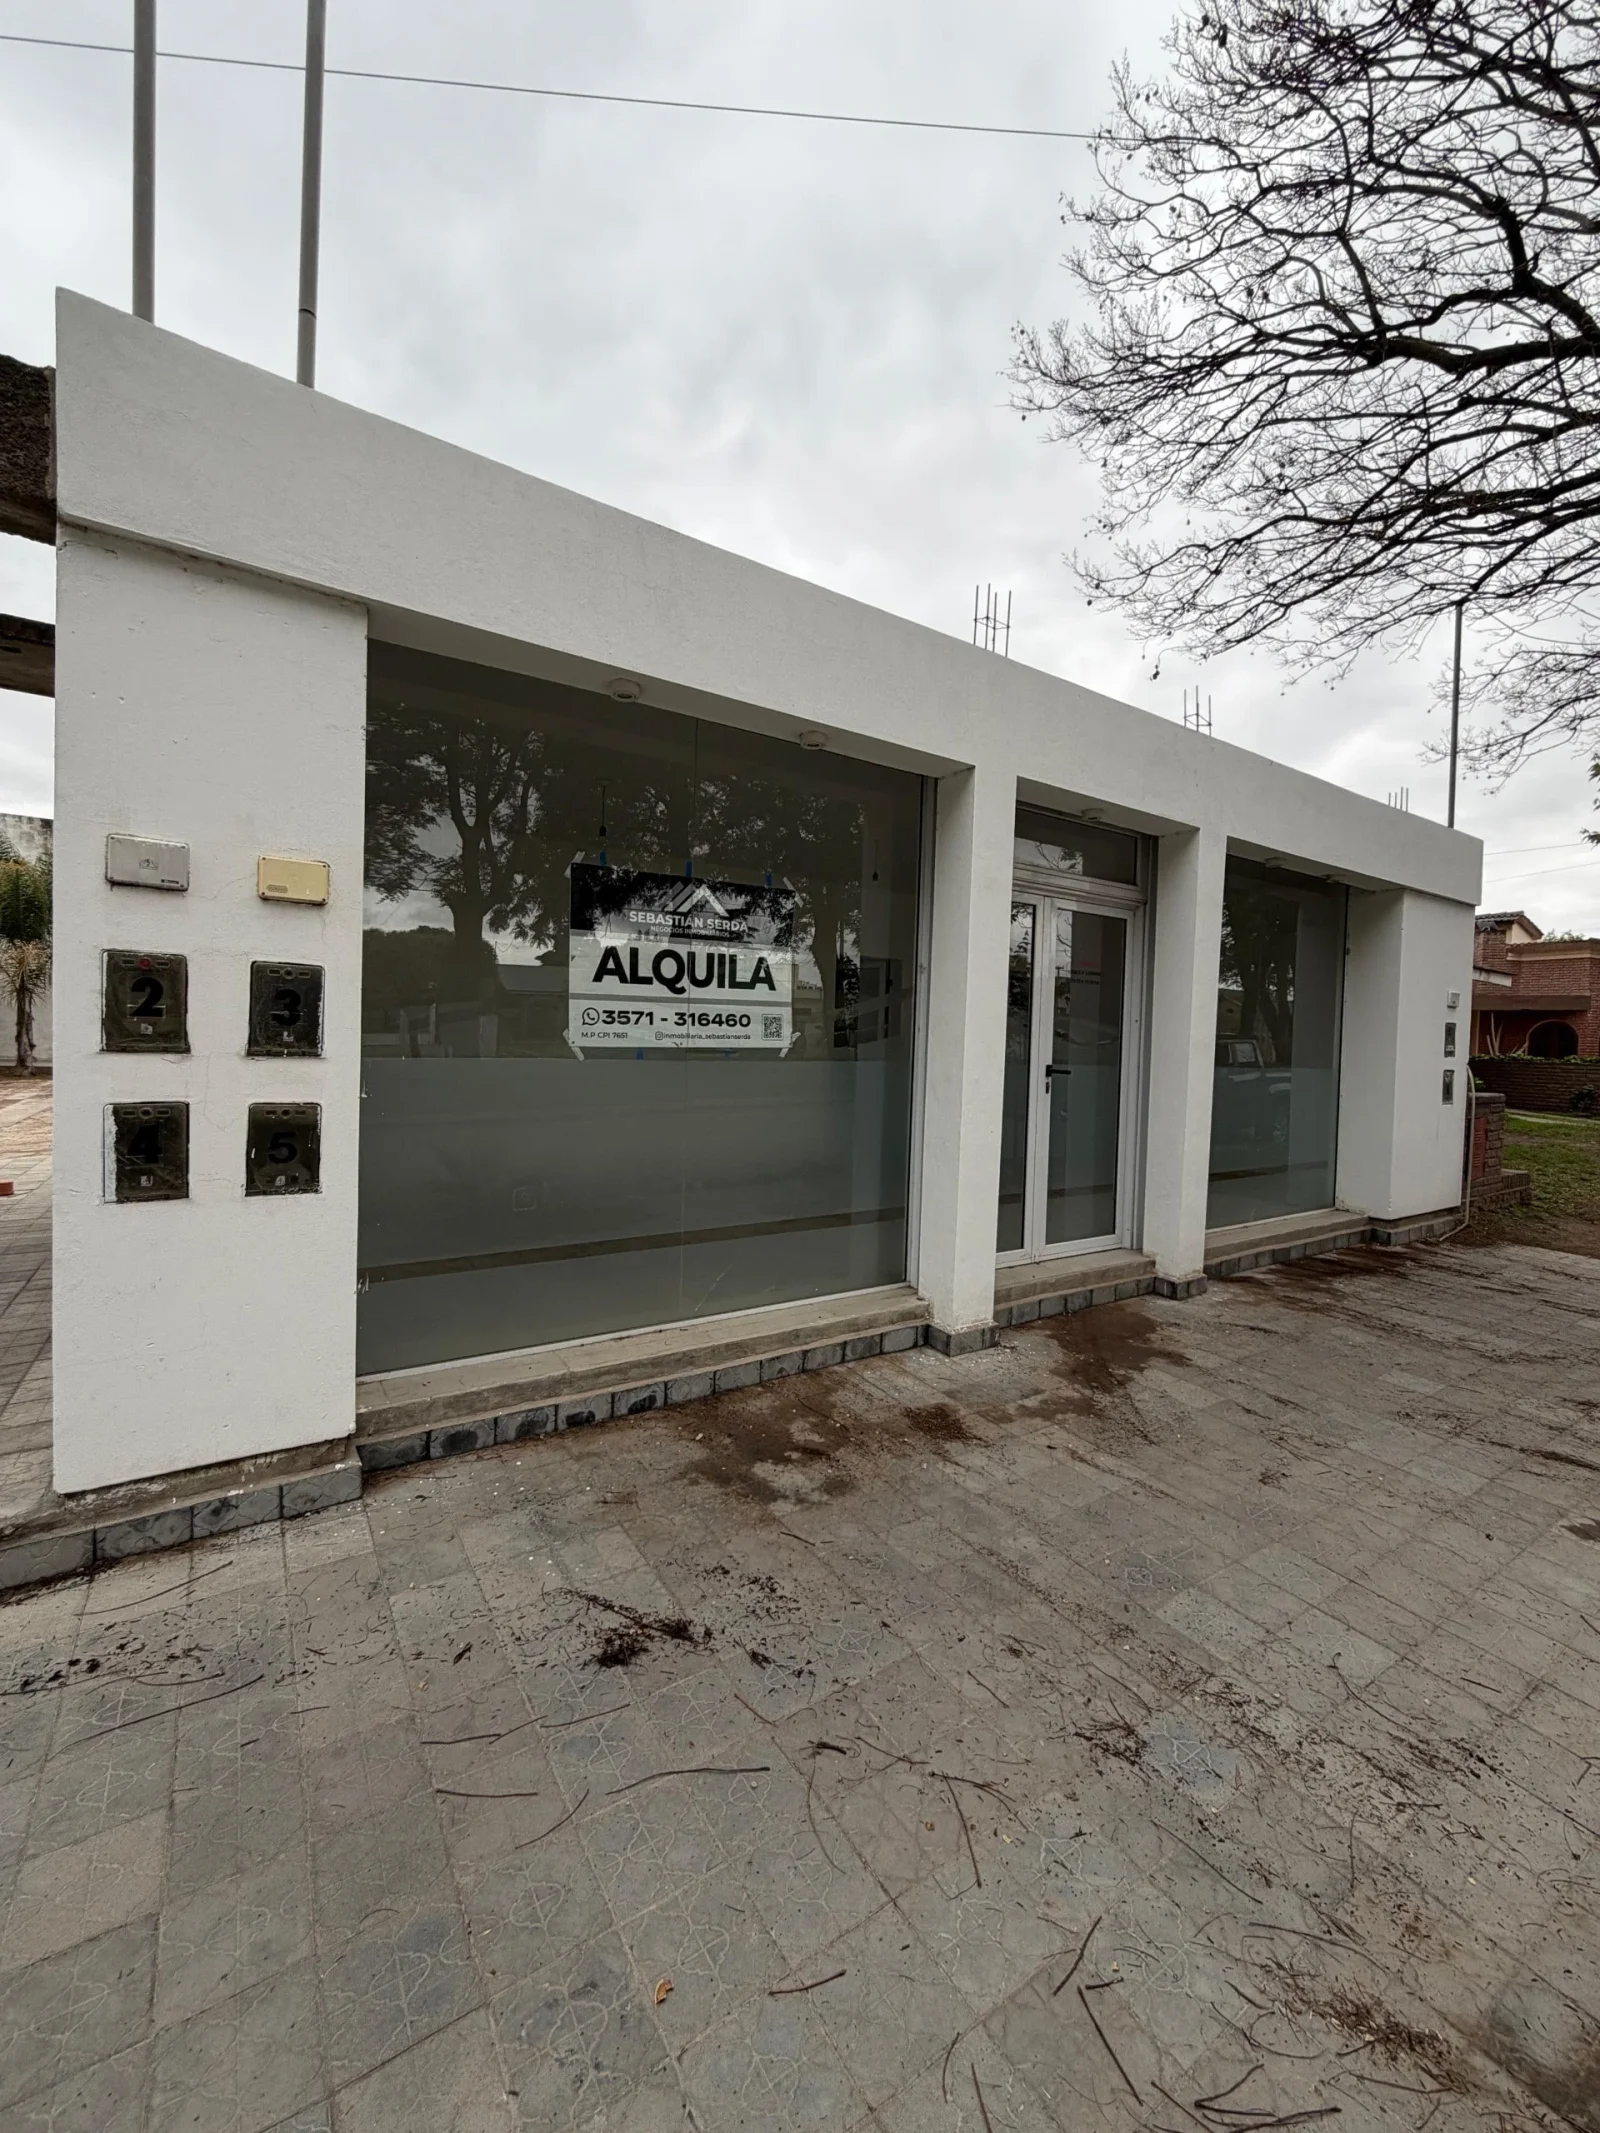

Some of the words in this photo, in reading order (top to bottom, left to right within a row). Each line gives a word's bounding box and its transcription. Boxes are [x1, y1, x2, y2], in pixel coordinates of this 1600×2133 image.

[650, 925, 684, 934] NEGOCIOS
[707, 918, 749, 933] SERDA
[592, 945, 777, 996] ALQUILA
[129, 976, 164, 1018] 2
[271, 988, 302, 1027] 3
[601, 1009, 654, 1026] 3571
[673, 1012, 751, 1028] 316460
[126, 1124, 164, 1164] 4
[268, 1131, 298, 1165] 5
